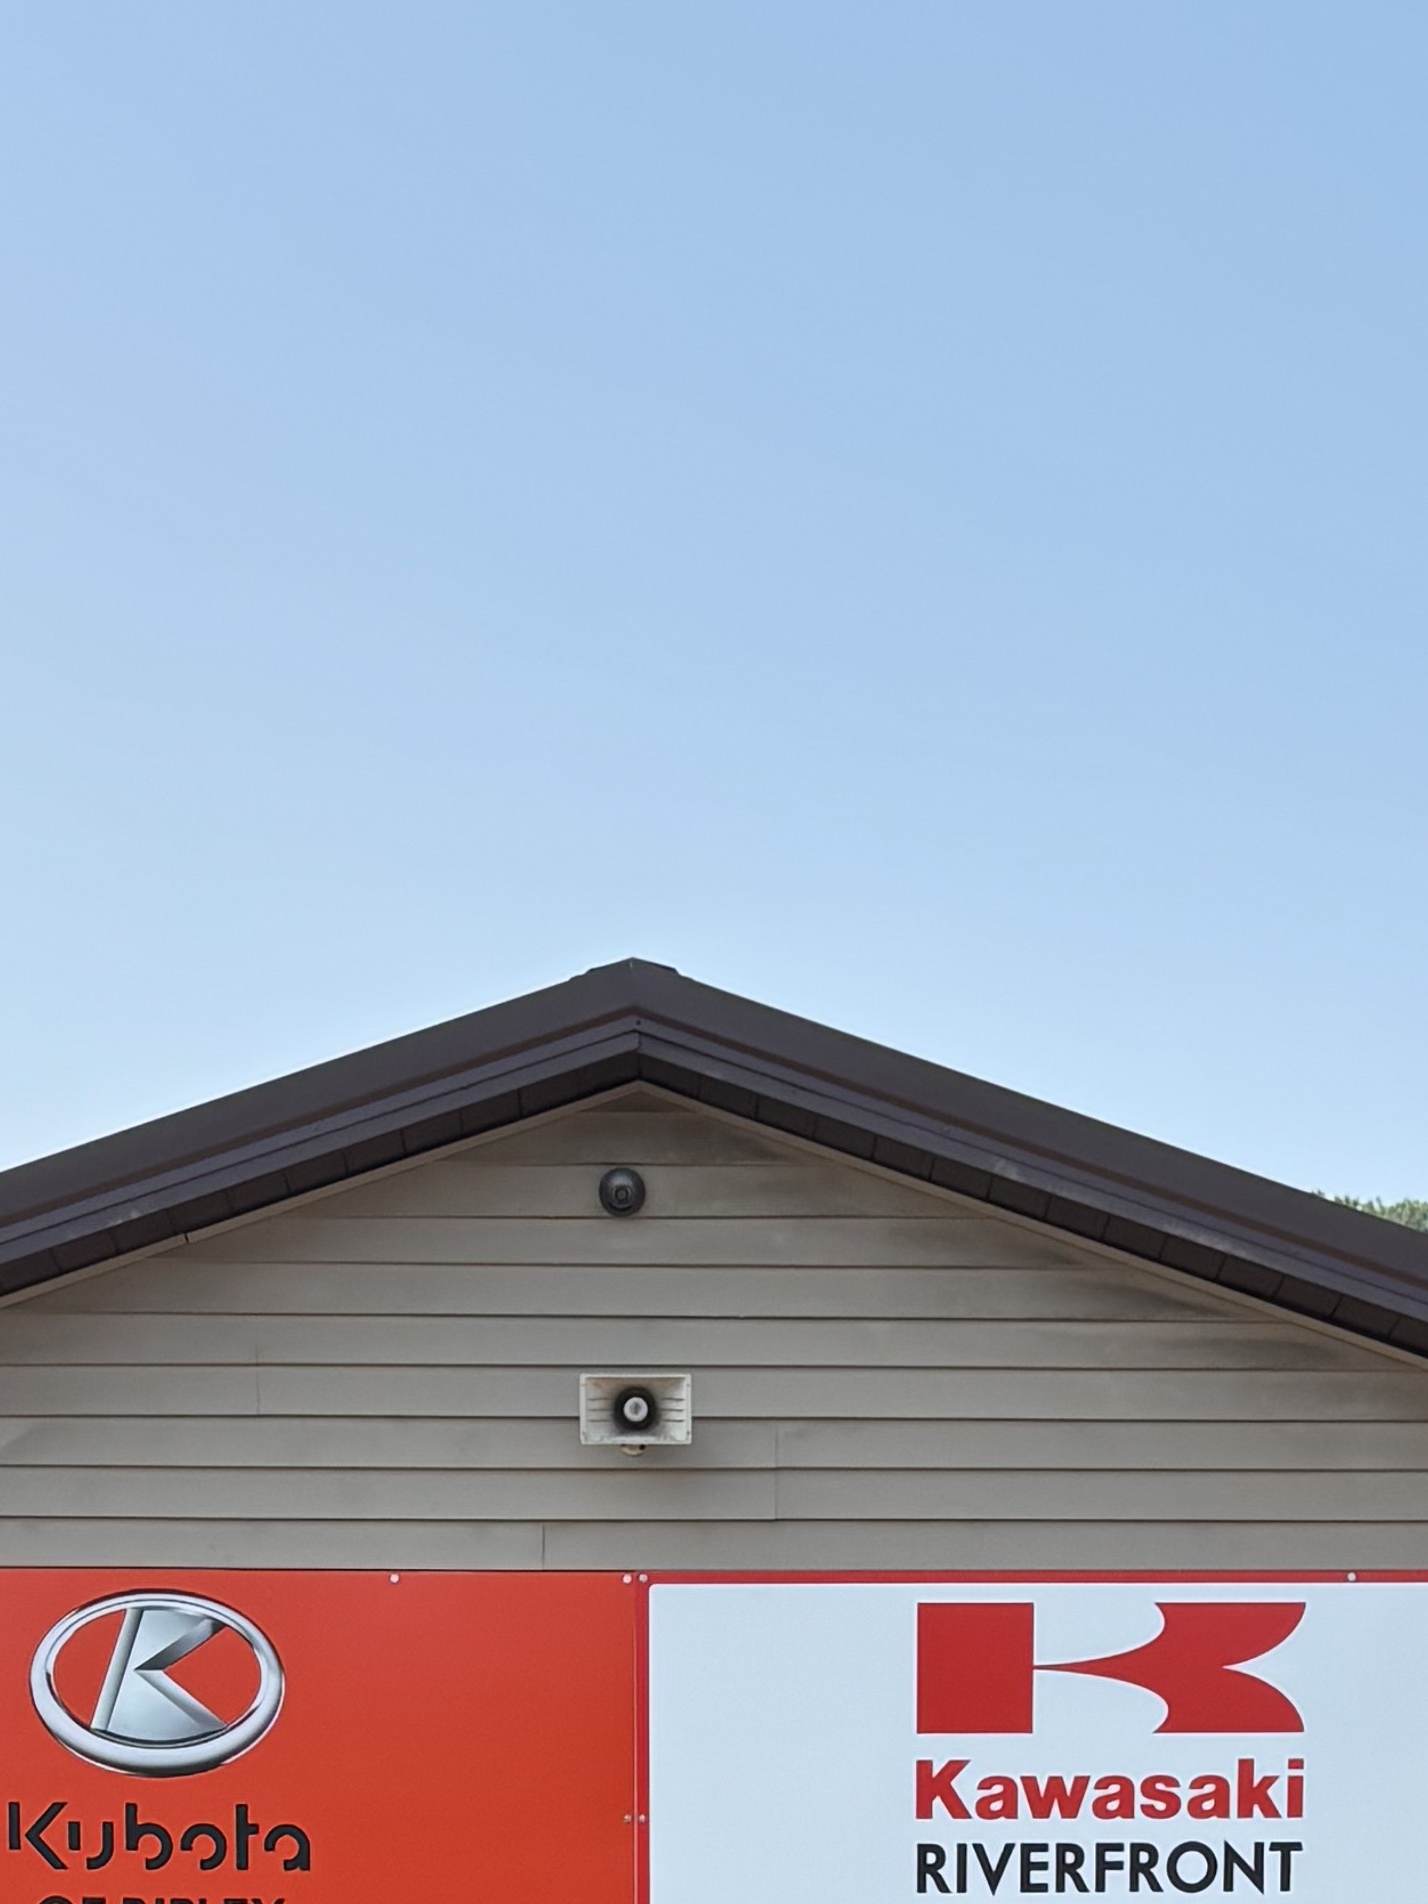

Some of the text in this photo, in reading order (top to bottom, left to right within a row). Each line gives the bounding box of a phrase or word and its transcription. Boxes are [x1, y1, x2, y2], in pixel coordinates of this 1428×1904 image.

[915, 1757, 1305, 1820] Kawasaki
[7, 1801, 311, 1872] Kubota
[916, 1839, 1304, 1897] RIVERFRONT
